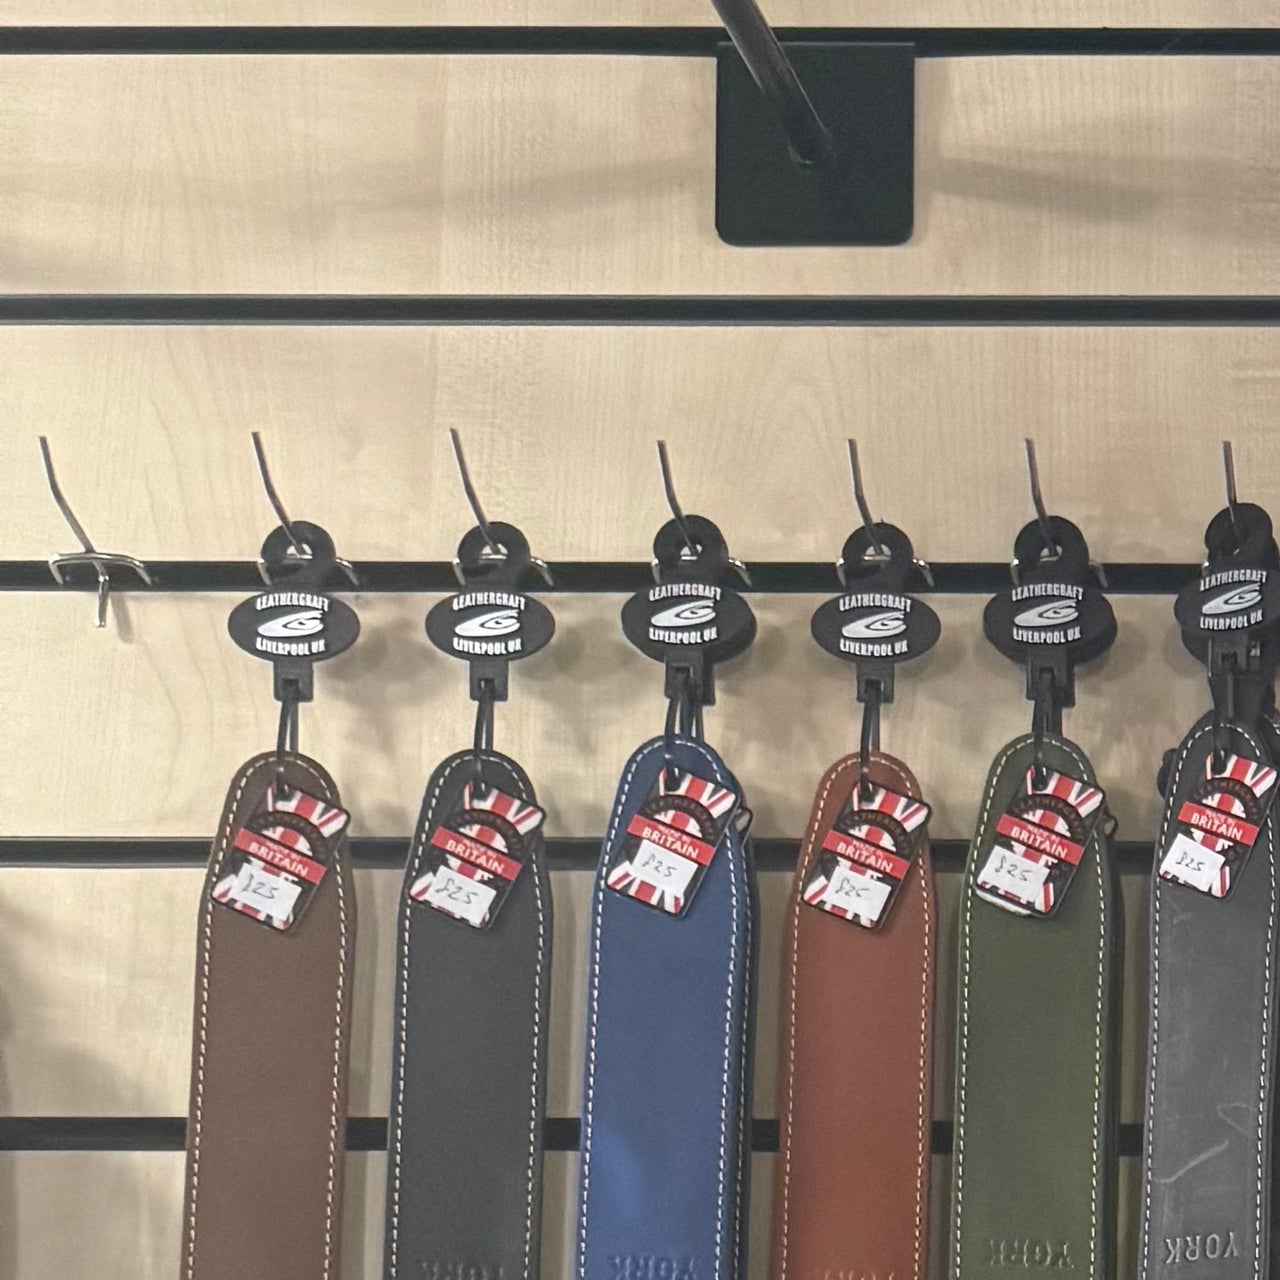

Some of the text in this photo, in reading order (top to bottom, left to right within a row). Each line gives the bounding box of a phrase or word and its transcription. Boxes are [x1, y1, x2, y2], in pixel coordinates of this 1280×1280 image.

[1200, 609, 1263, 630] LIVERPOOL UK
[256, 637, 326, 656] LIVERPOOL UK
[453, 637, 522, 656] LIVERPOOL UK
[649, 627, 717, 644] LIVERPOOL UK
[839, 638, 908, 656] LIVERPOOL UK
[1012, 626, 1081, 644] LIVERPOOL UK
[1190, 813, 1243, 841] BRITAIN
[642, 826, 700, 859] BRITAIN
[1010, 826, 1069, 859] BRITAIN
[249, 841, 309, 876] BRITAIN
[446, 839, 505, 875] BRITAIN
[836, 841, 894, 873] BRITAIN
[1164, 1231, 1241, 1265] YORK
